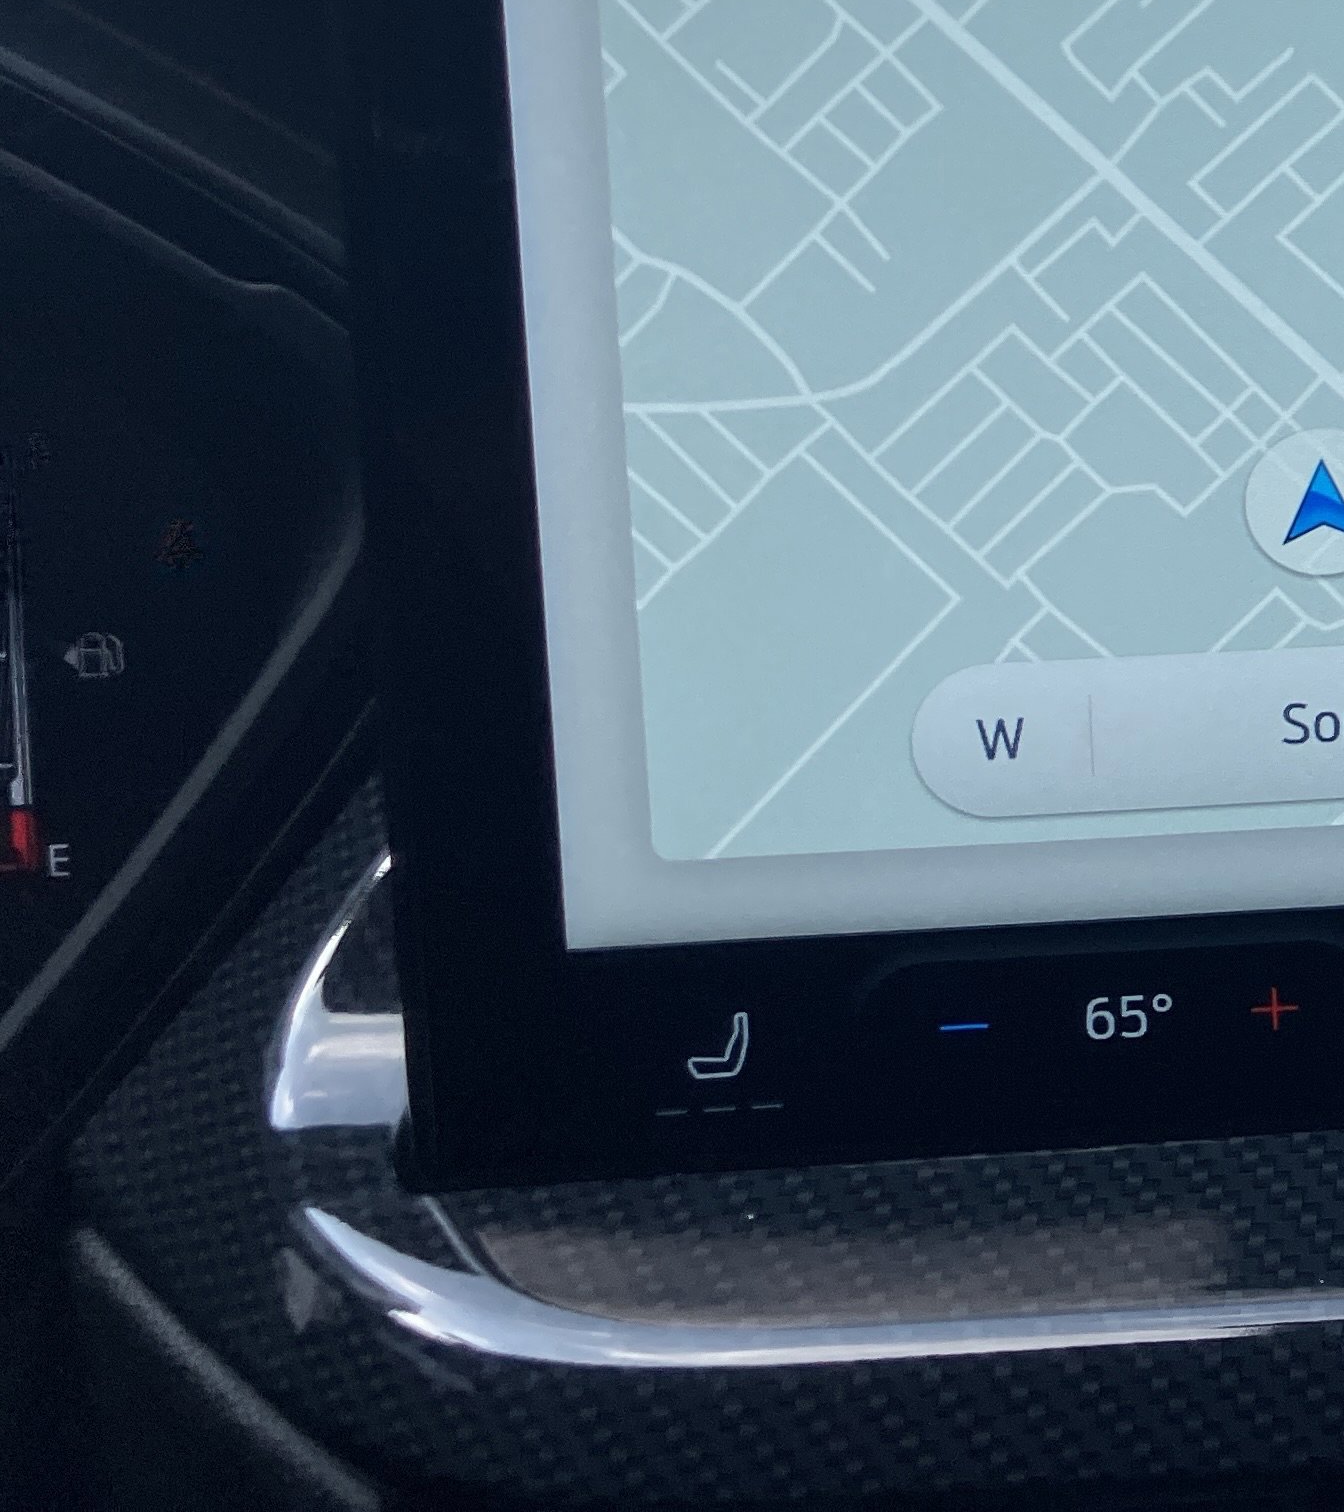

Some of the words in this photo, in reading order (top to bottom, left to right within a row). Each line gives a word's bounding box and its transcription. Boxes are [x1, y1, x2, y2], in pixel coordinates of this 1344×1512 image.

[975, 717, 1026, 761] W
[48, 843, 70, 877] E
[1085, 992, 1173, 1042] 65°
